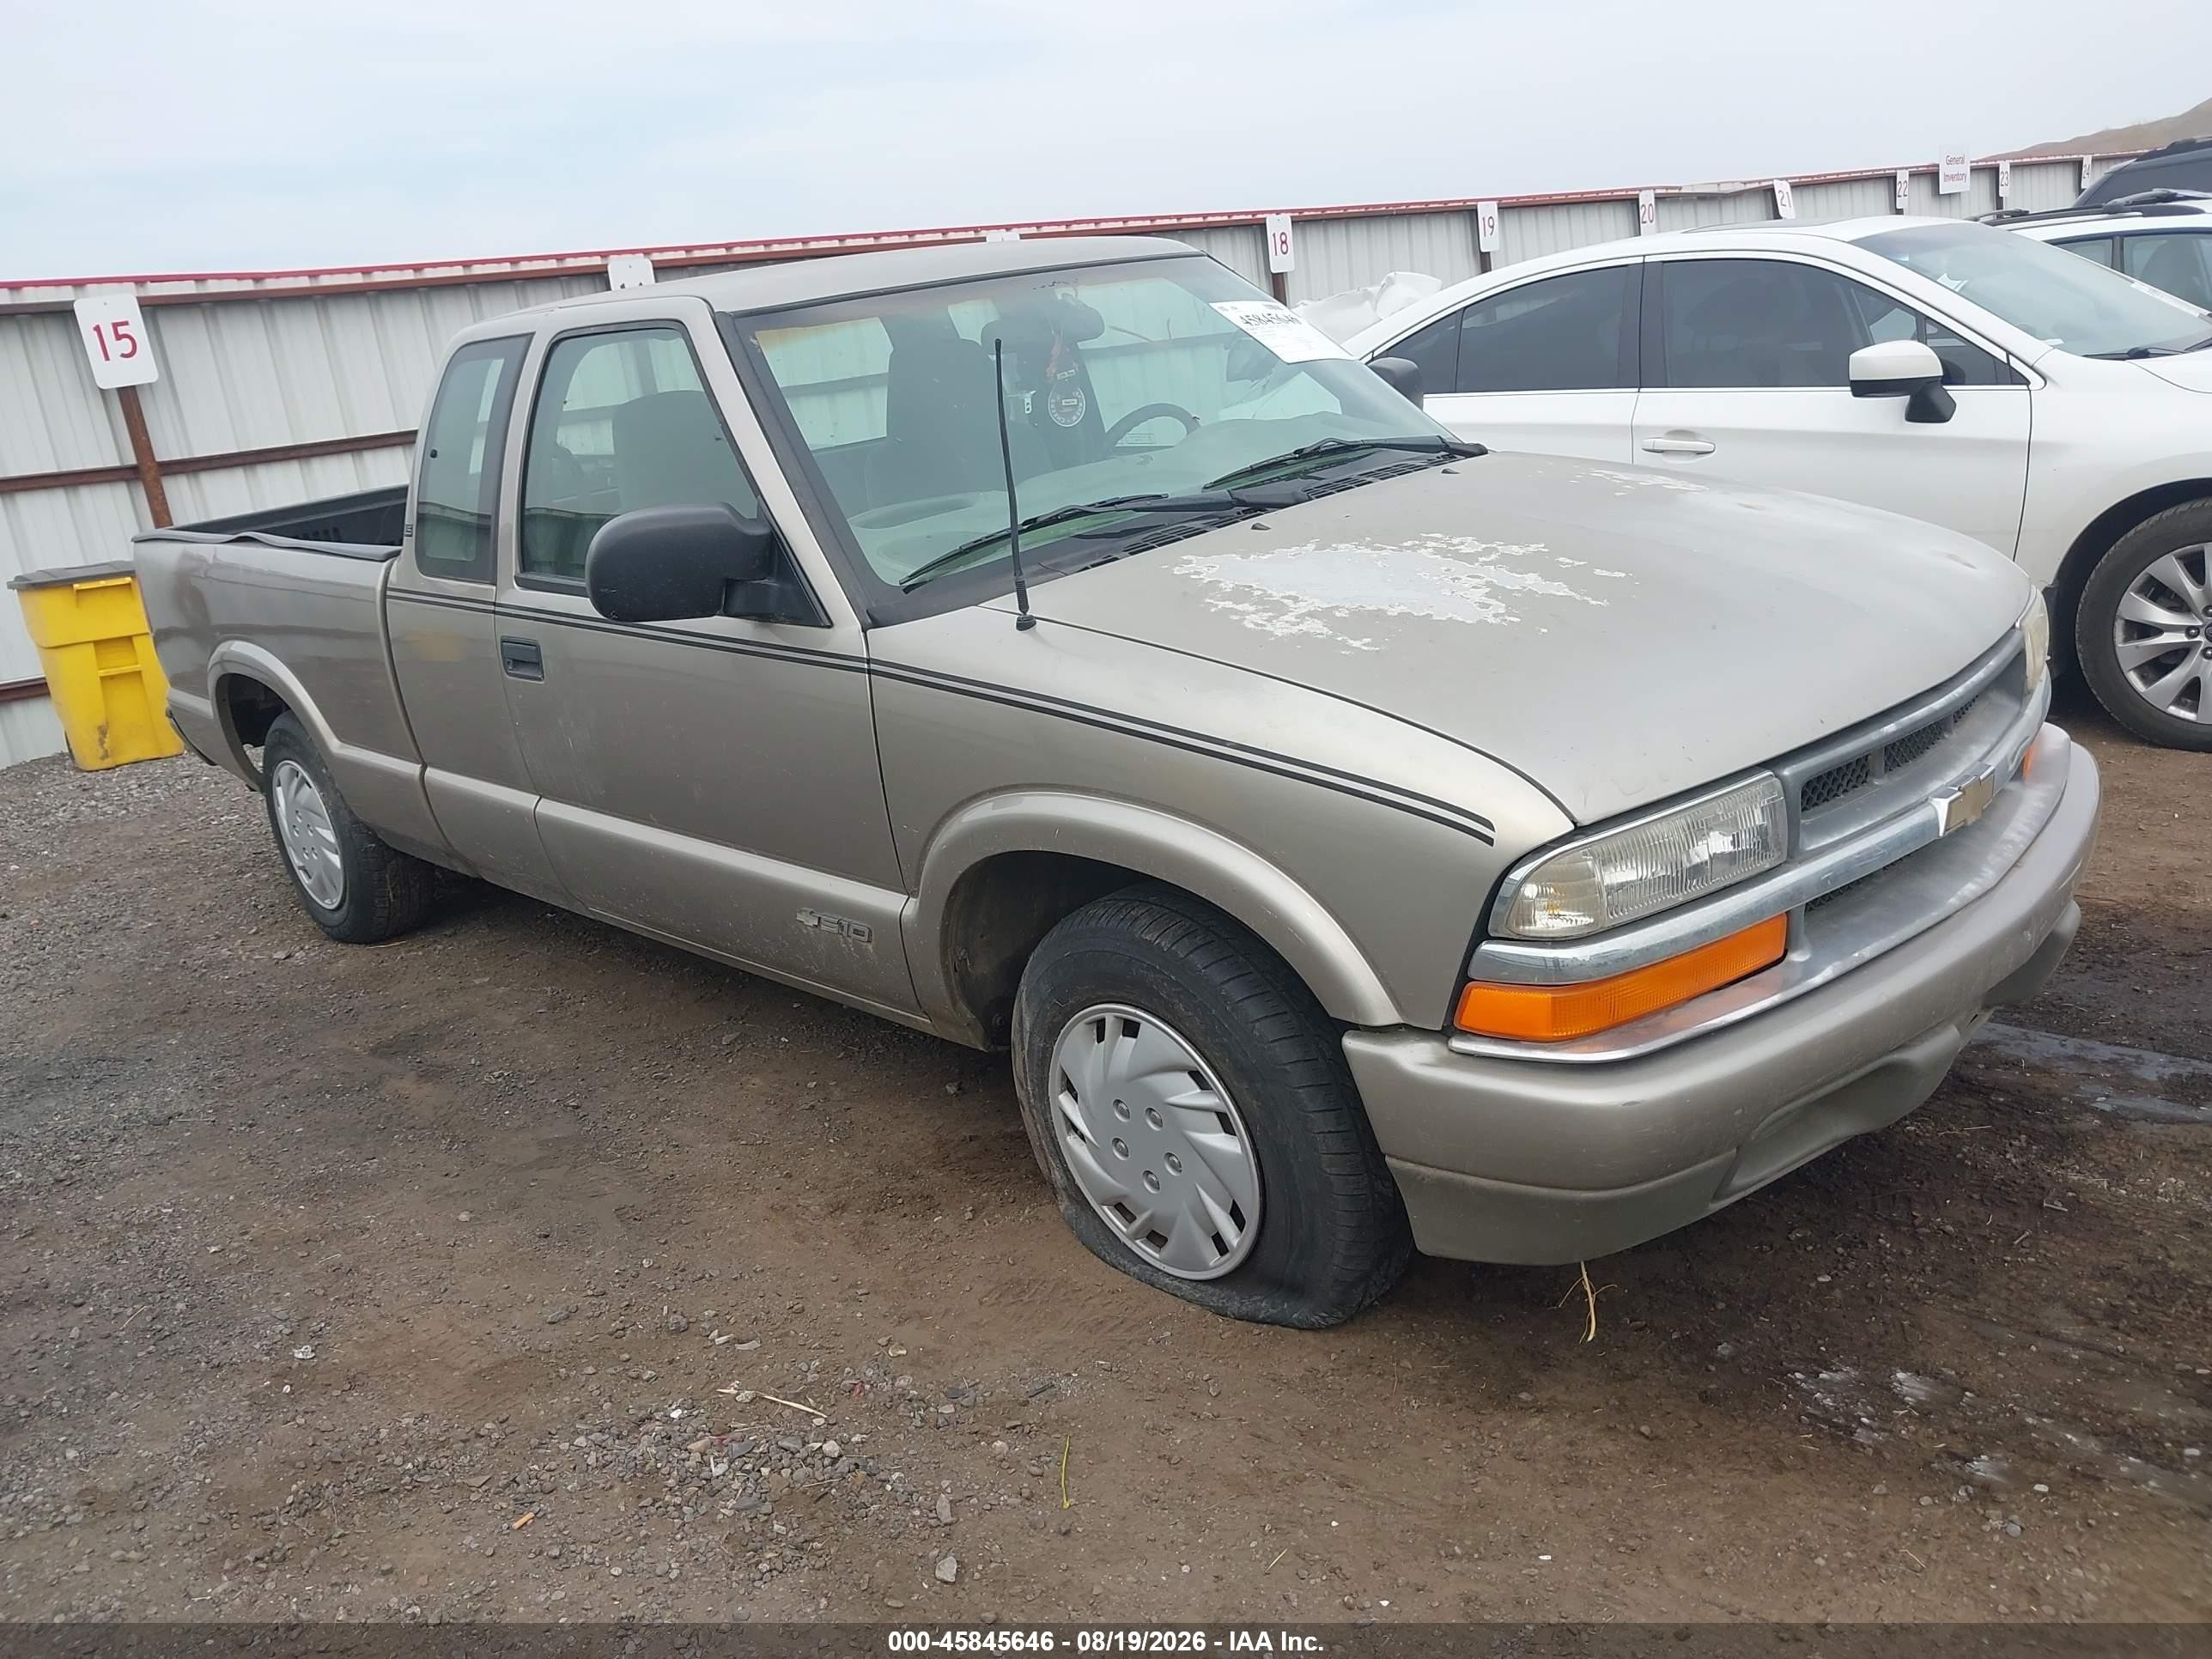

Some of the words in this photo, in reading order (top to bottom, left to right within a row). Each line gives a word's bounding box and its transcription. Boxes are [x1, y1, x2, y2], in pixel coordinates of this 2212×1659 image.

[1945, 154, 1966, 166] General
[1943, 171, 1967, 184] Inventory
[2000, 171, 2009, 187] 23
[2082, 164, 2091, 179] 24
[1897, 179, 1908, 198] 22
[1778, 189, 1792, 208] 21
[1640, 203, 1655, 224] 20
[1481, 216, 1495, 238] 19
[1272, 231, 1289, 257] 18
[1239, 312, 1303, 326] 45845646
[92, 319, 137, 362] 15
